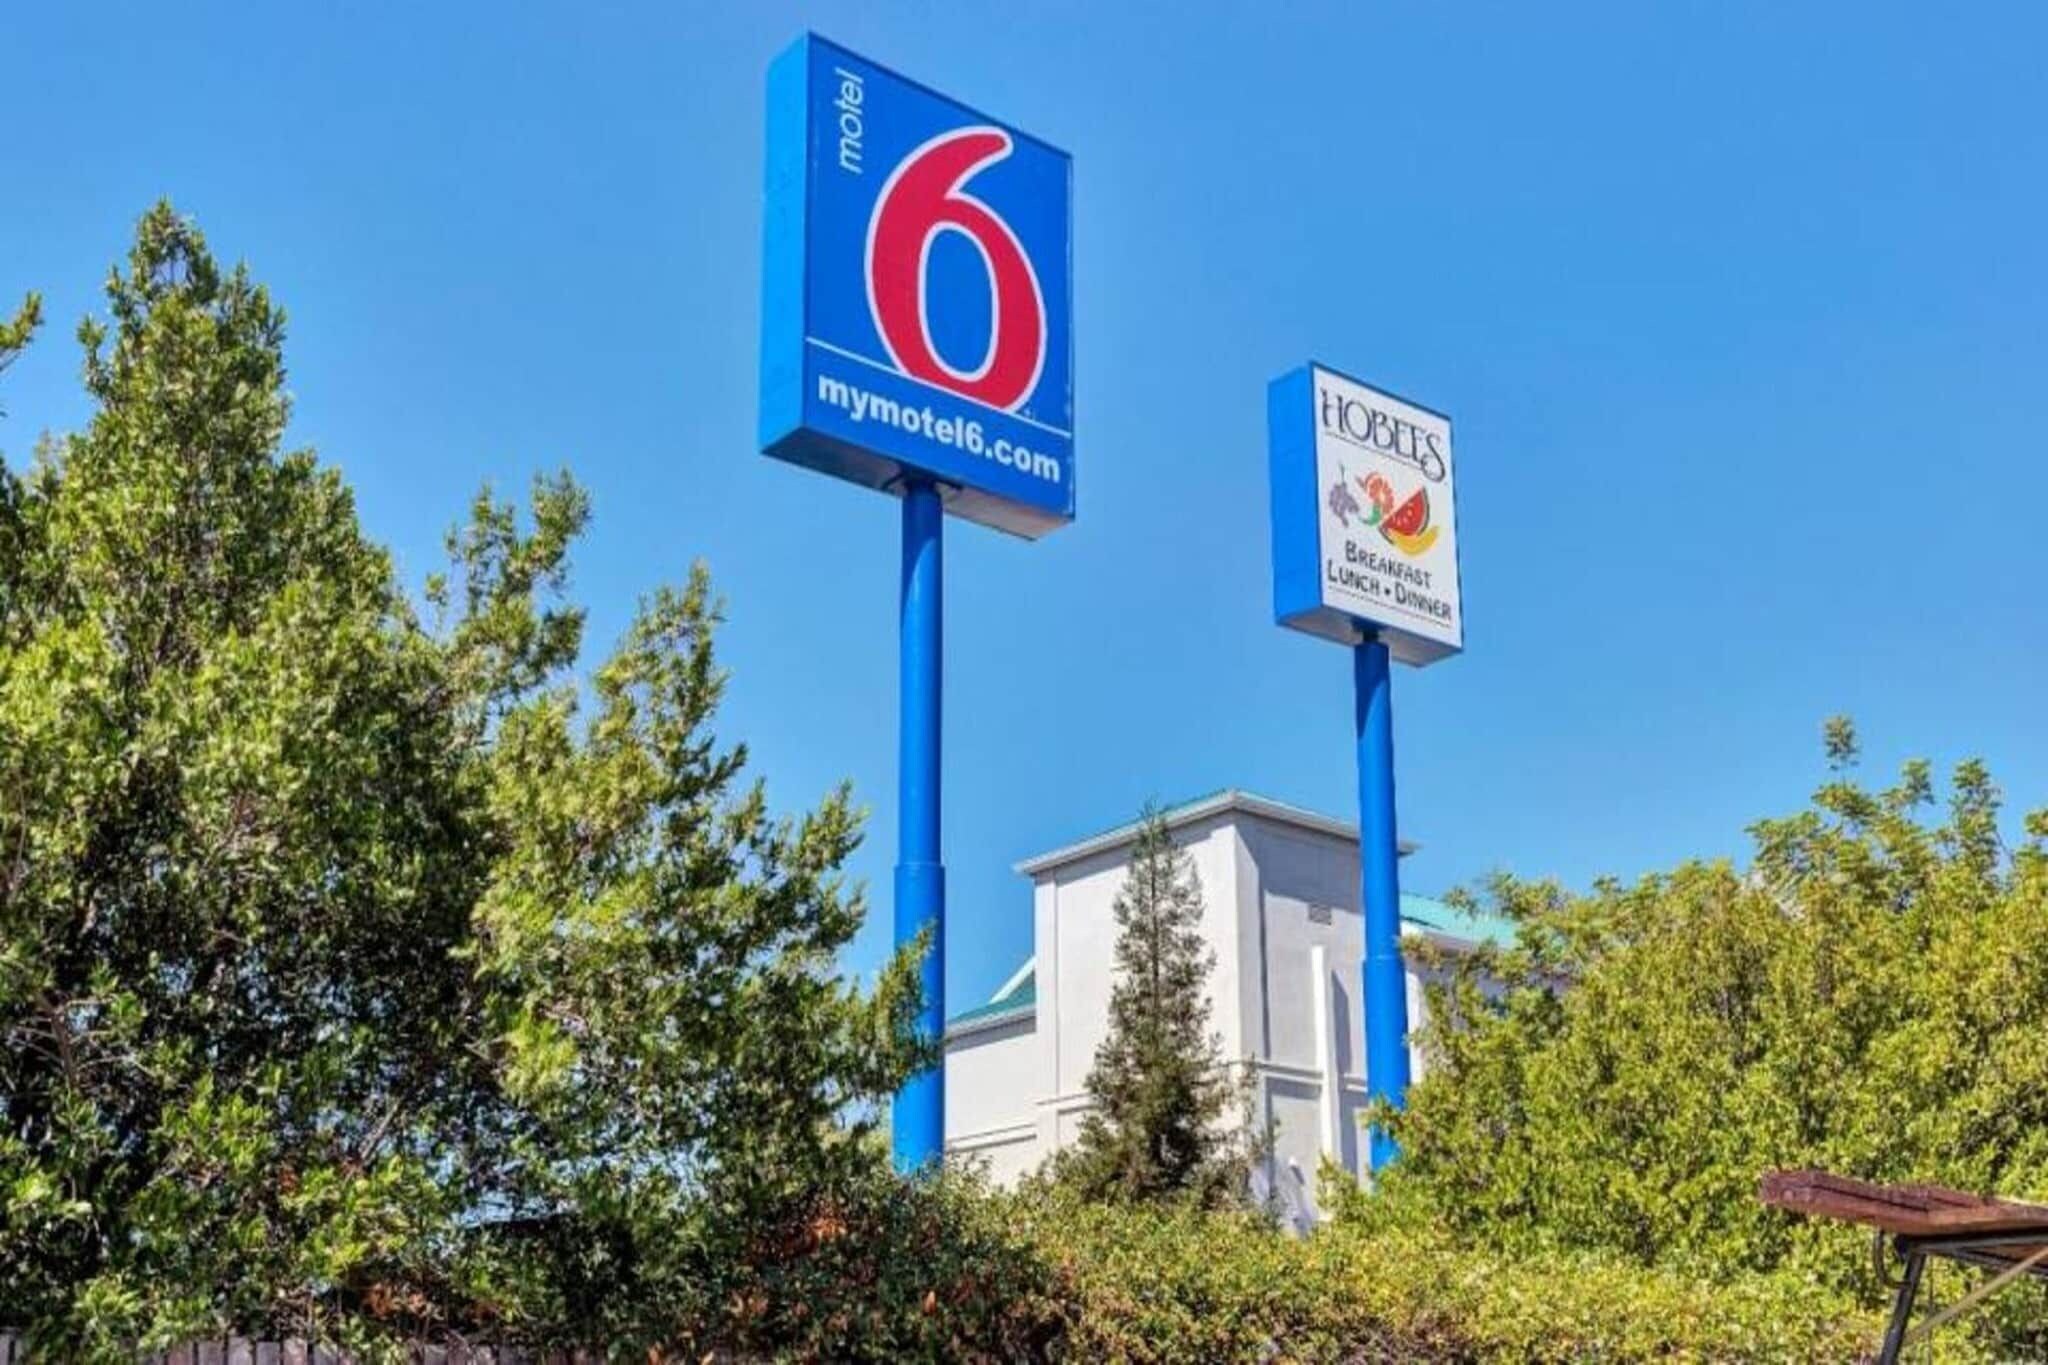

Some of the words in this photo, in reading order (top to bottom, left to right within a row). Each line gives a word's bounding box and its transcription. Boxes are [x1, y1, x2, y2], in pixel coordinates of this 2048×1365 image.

[834, 67, 864, 174] motel
[864, 125, 1047, 416] 6
[818, 374, 1060, 483] mymotel6.com
[1327, 559, 1380, 596] LUNCH
[1395, 581, 1452, 620] DINNER
[1345, 540, 1432, 590] BREAKFAST
